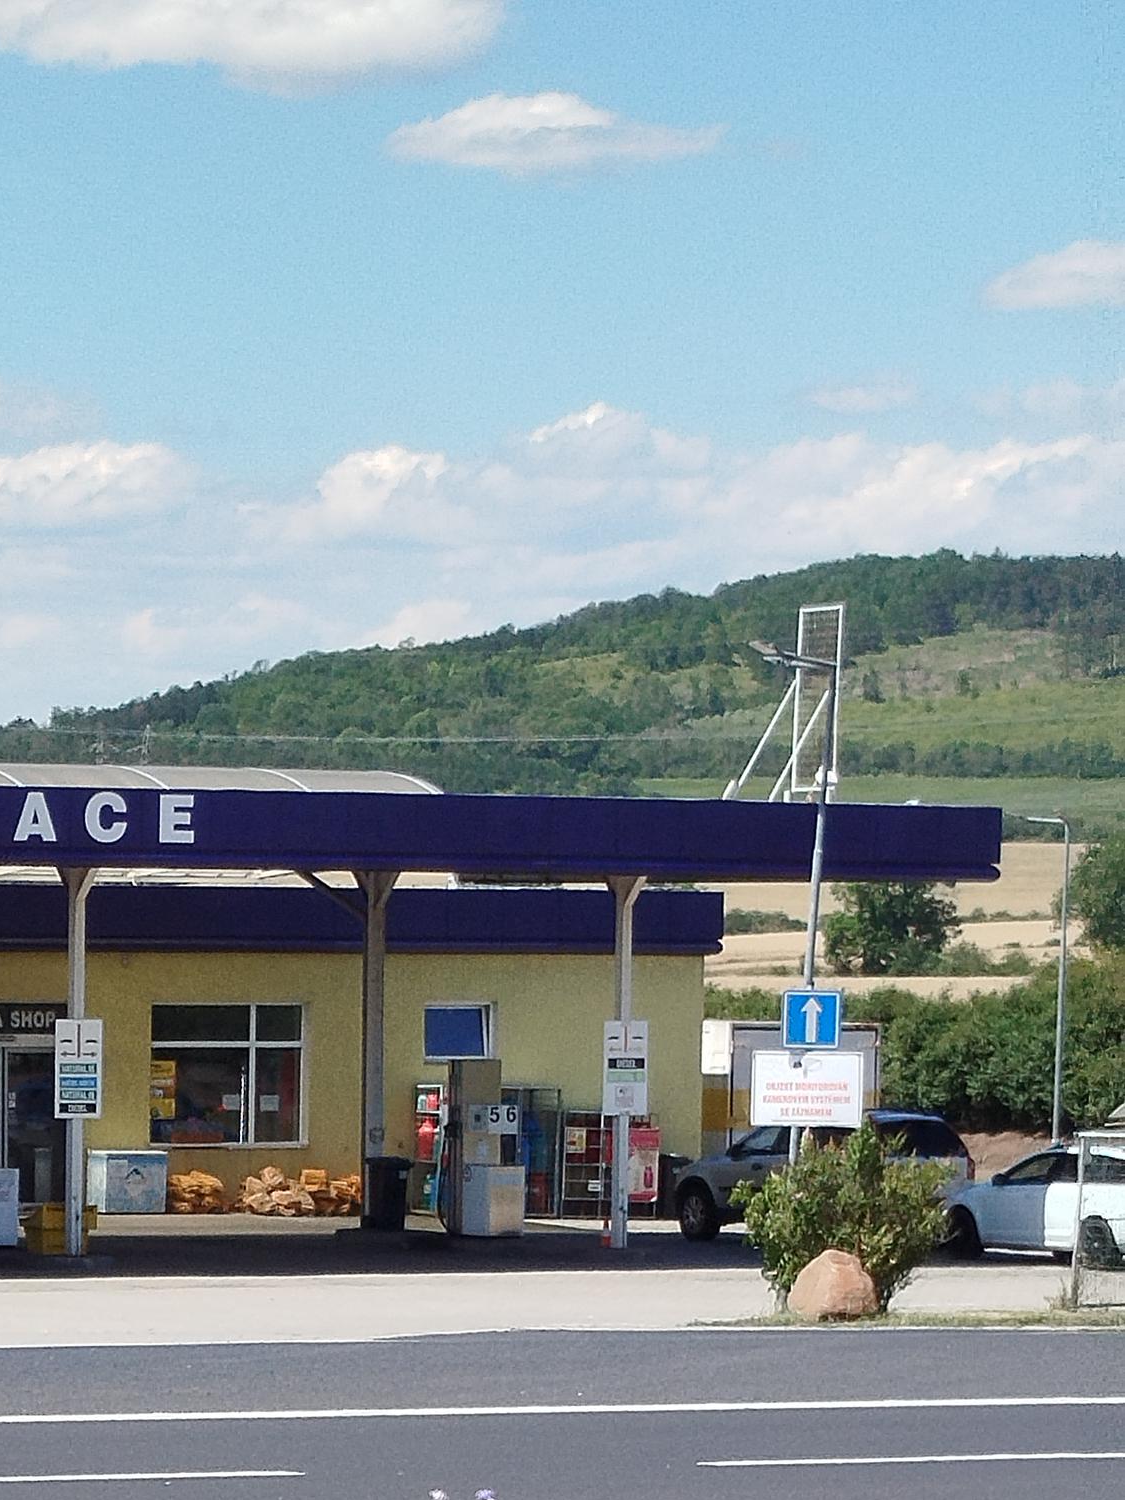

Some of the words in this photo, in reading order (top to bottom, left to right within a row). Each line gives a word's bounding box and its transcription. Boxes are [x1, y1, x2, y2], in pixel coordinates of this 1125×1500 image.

[10, 1010, 56, 1028] SHOP
[489, 1106, 501, 1123] 5
[506, 1106, 517, 1123] 6
